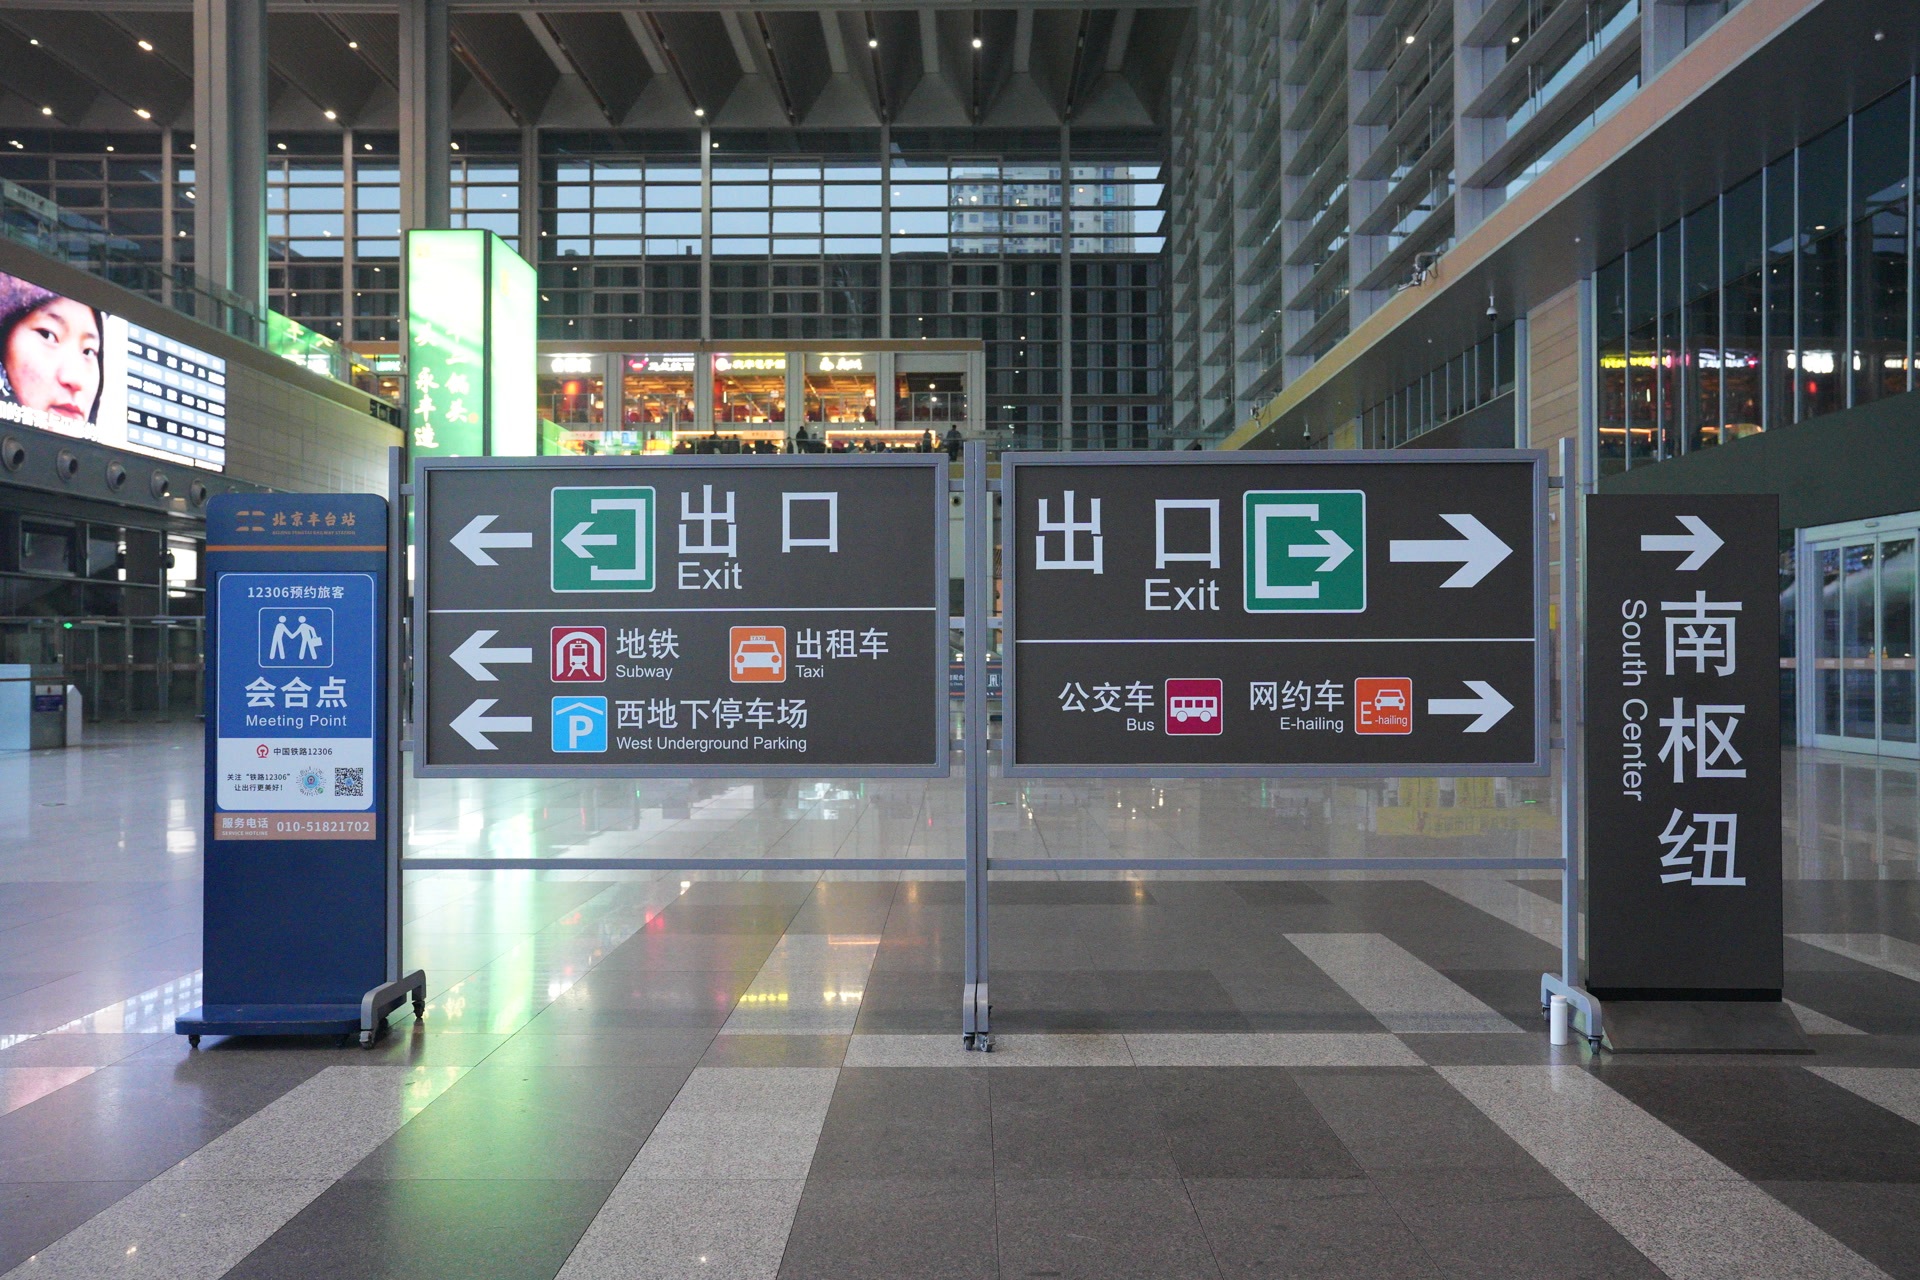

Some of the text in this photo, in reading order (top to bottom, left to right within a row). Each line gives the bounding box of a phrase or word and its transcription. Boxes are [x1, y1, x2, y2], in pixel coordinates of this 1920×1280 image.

[271, 511, 357, 527] 北京丰台站
[679, 562, 742, 589] Exit
[248, 586, 344, 598] 12306预约旅客
[1146, 579, 1219, 610] Exit
[616, 628, 679, 659] 地铁
[797, 628, 888, 659] 出租车
[616, 665, 672, 680] Subway
[796, 665, 823, 677] Taxi
[245, 676, 347, 708] 会合点
[1058, 681, 1154, 713] 公交车
[1250, 680, 1344, 712] 网约车
[1622, 599, 1648, 801] South Center
[247, 715, 346, 729] Meeting Point
[615, 697, 807, 729] 西地下停车场
[1127, 718, 1154, 731] Bus
[1281, 717, 1343, 733] E-hailing
[617, 737, 806, 752] West Underground Parking
[1658, 591, 1746, 886] 南枢纽
[273, 747, 333, 756] 中国铁路12306
[222, 817, 369, 831] 服务电话 010-51821702
